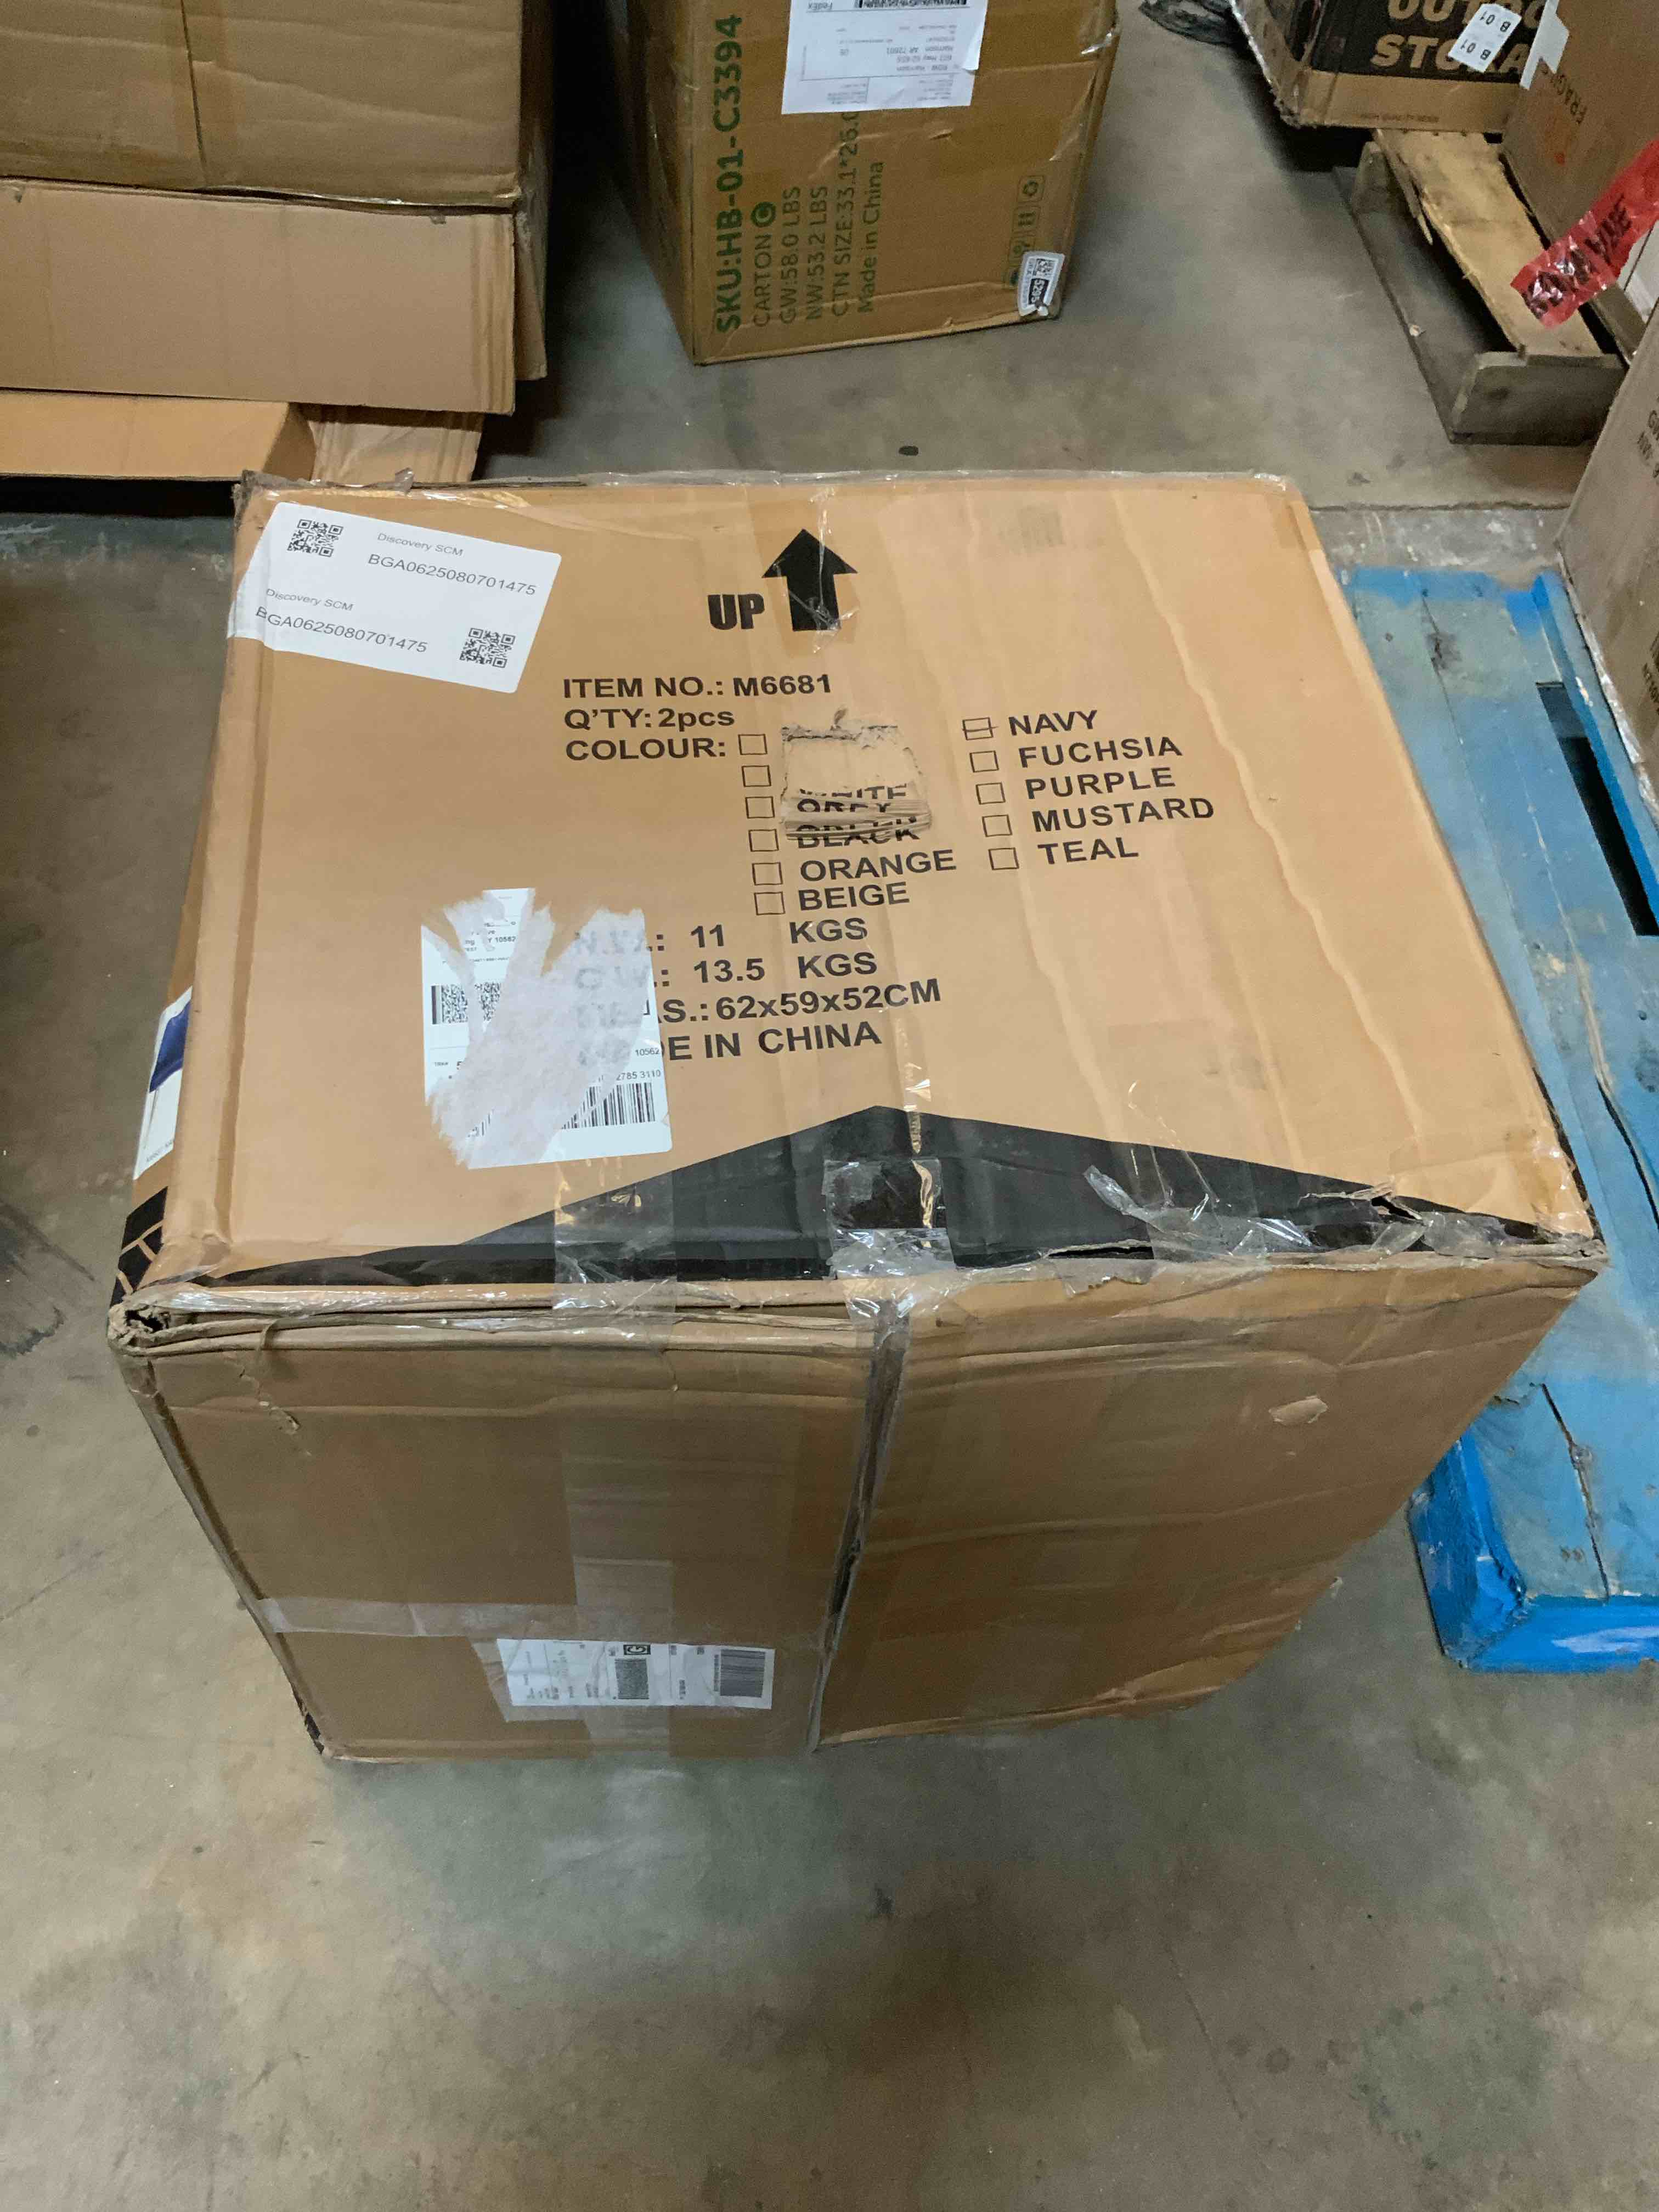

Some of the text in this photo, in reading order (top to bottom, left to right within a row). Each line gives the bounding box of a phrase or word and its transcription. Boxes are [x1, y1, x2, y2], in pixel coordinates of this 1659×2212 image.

[1500, 21, 1511, 32] B
[1480, 49, 1492, 61] B
[714, 14, 743, 332] SKU:HB-01-C3394
[782, 187, 801, 227] LBS
[805, 186, 827, 320] NW:53.2 LBS
[858, 162, 885, 313] Made in China
[753, 234, 772, 328] CARTON
[832, 272, 850, 317] CTN
[377, 532, 464, 557] Discovery SCM
[367, 553, 537, 596] BGA0625080701475
[266, 588, 354, 611] Discovery SCM
[708, 593, 765, 630] UP
[255, 606, 428, 653] BGA0625080701475
[563, 674, 832, 699] ITEM NO.: M6681
[1008, 709, 1098, 736] NAVY
[566, 737, 727, 761] COLOUR:
[1018, 736, 1183, 769] FUCHSIA
[1025, 766, 1176, 800] PURPLE
[1031, 797, 1215, 833] MUSTARD
[800, 849, 957, 882] ORANGE
[1037, 837, 1139, 865] TEAL
[798, 881, 910, 911] BEIGE
[691, 924, 725, 949] 11
[789, 918, 868, 944] KGS
[693, 958, 765, 984] 13.5
[798, 952, 878, 979] KGS
[716, 978, 941, 1021] 62x59x52CM
[635, 1047, 660, 1057] 10562
[705, 1032, 741, 1059] IN
[758, 1021, 883, 1054] CHINA
[640, 1069, 662, 1079] 3110
